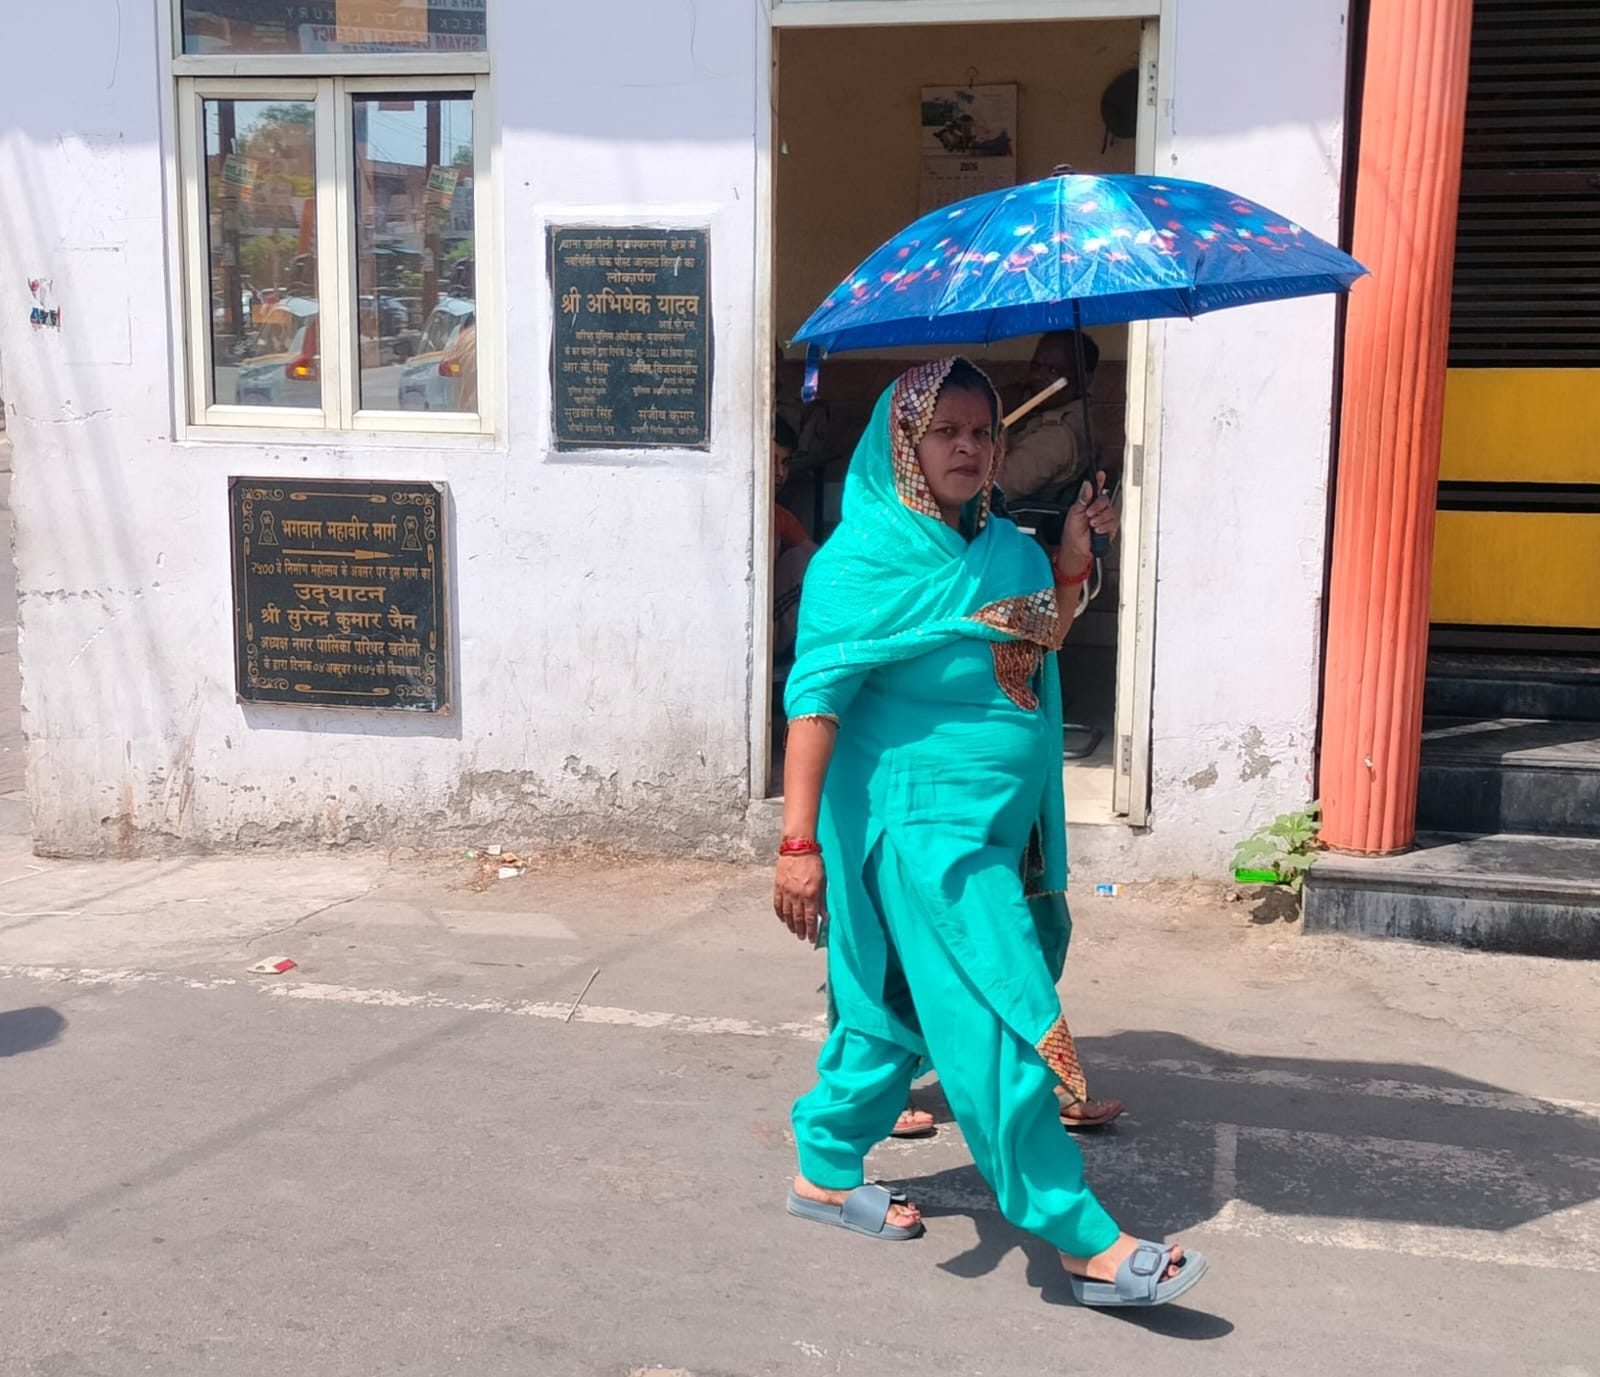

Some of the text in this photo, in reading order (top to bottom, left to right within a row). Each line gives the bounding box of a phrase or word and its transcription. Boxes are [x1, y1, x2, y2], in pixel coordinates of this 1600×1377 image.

[605, 269, 657, 284] लोकार्पण
[561, 286, 700, 319] श्री अभिषेक यादव
[669, 409, 695, 424] कुमार
[281, 515, 397, 542] भगवान महावीर मार्ग
[311, 559, 338, 579] महोत्सव
[341, 561, 349, 577] के
[351, 565, 373, 580] अवसर
[376, 566, 387, 580] पर
[389, 566, 401, 582] इस
[403, 561, 418, 580] मार्ग
[420, 568, 431, 581] का
[293, 583, 387, 607] उद्घाटन
[261, 602, 417, 634] श्री सुरेन्द्र कुमार जैन
[261, 633, 421, 657] अध्यक्ष नगर पालिका परिषद खतौली
[263, 656, 271, 669] के
[272, 659, 288, 670] द्वारा
[290, 655, 312, 671] दिनांक
[376, 660, 386, 675] को
